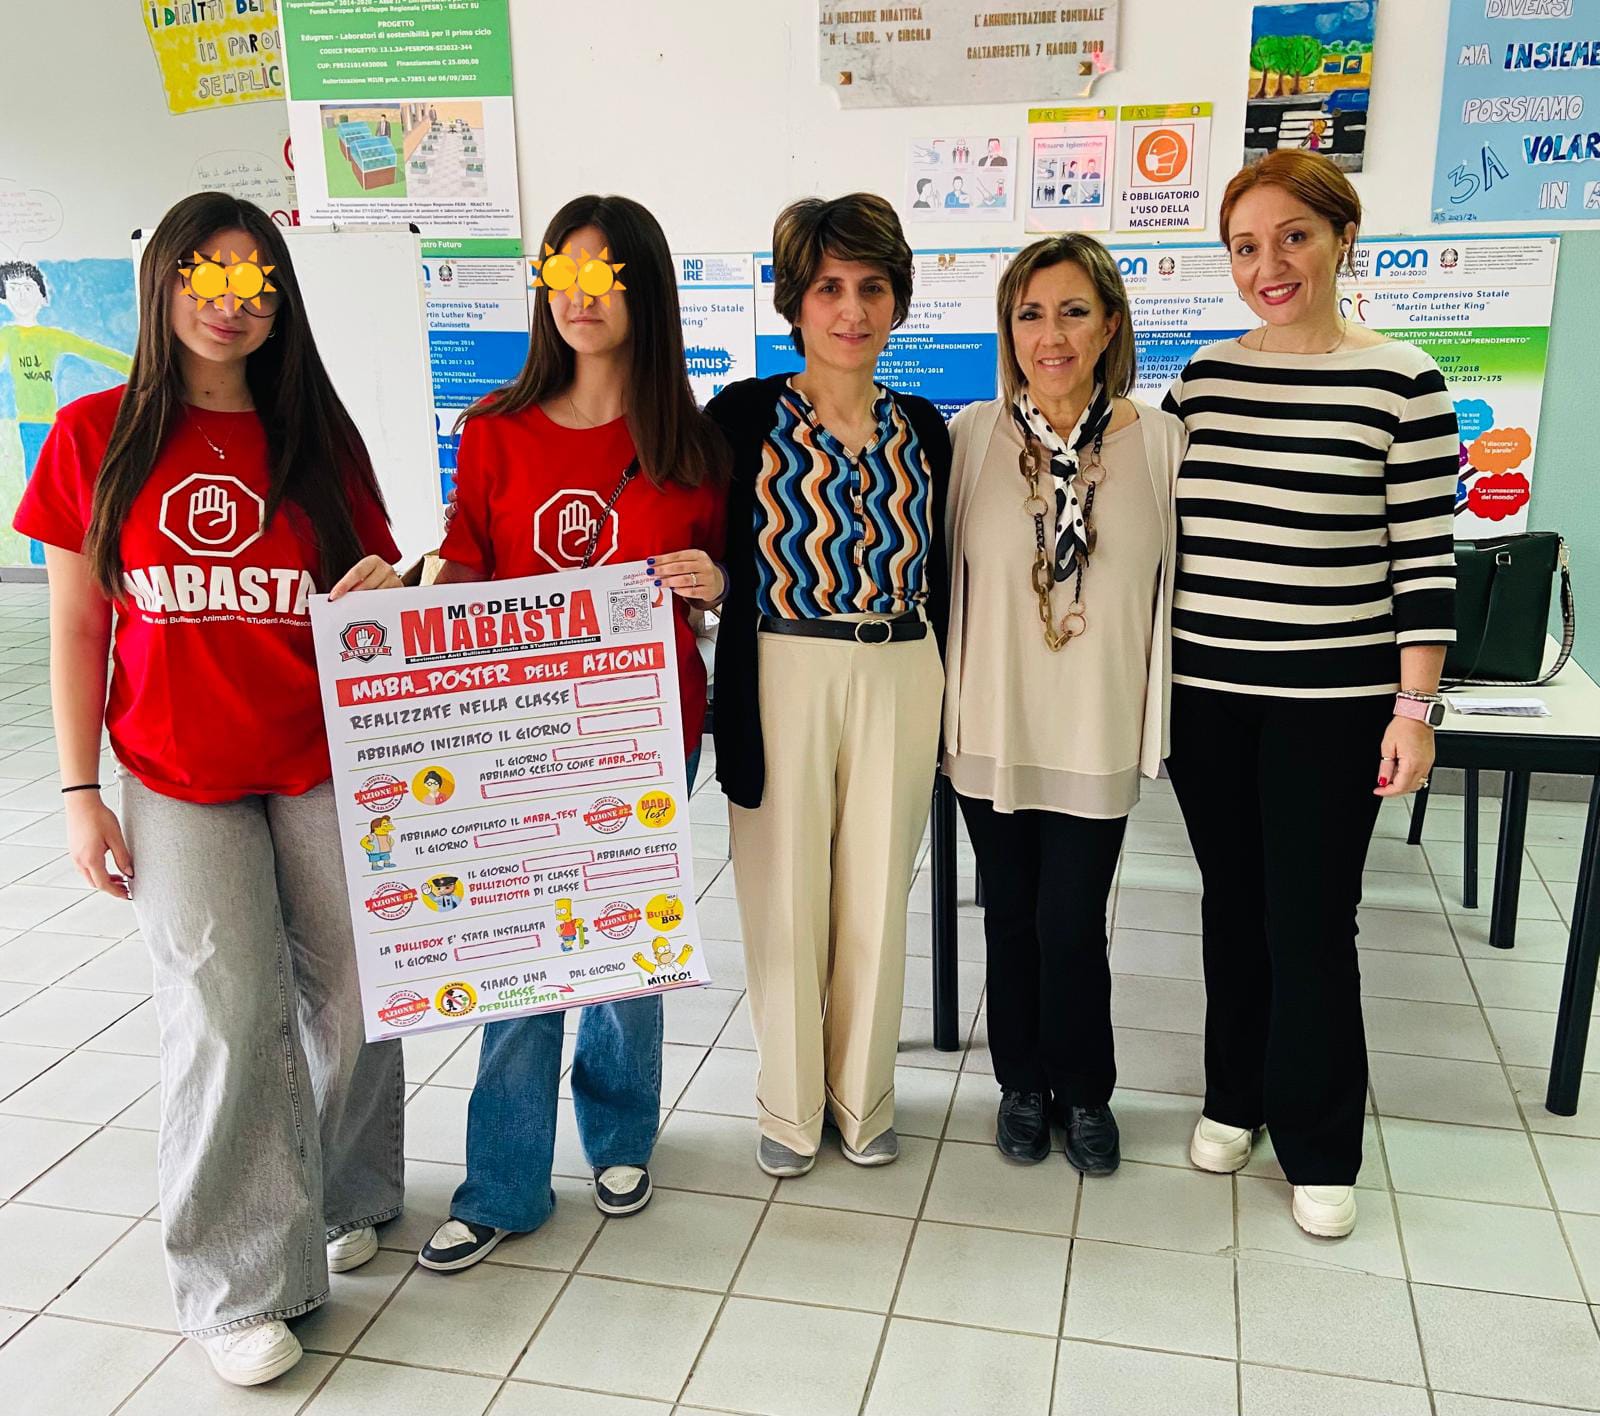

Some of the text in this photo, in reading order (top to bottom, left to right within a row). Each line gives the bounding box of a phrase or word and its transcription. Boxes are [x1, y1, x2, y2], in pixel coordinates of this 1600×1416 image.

[837, 7, 923, 24] DIREZIONE DIDATTICA
[1060, 8, 1105, 23] COMUNALE
[377, 20, 415, 28] PROGETTO
[340, 31, 377, 40] Laboratori
[475, 28, 492, 36] ciclo
[898, 28, 932, 42] CIRCOLO
[967, 41, 1077, 60] CALTANISSETTA 7 MAGGIO
[1457, 43, 1491, 66] MA
[1464, 95, 1584, 124] POSSIAMO
[1037, 141, 1064, 149] Misure
[1122, 190, 1200, 201] È OBBLIGATORIO
[1539, 181, 1569, 210] IN
[1130, 204, 1190, 214] L'USO DELLA
[1129, 217, 1190, 228] MASCHERINA
[438, 241, 463, 249] Futuro
[683, 259, 704, 270] IND
[1375, 248, 1429, 277] pon
[683, 271, 703, 281] IRE
[1134, 296, 1224, 306] Comprensivo Statale
[1374, 290, 1510, 301] Istituto Comprensivo Statale
[426, 301, 500, 310] Comprensivo Statale
[711, 304, 745, 312] Statale
[1151, 307, 1180, 315] Luther
[1430, 302, 1461, 311] Luther
[441, 311, 465, 319] Luther
[1133, 318, 1188, 327] Caltanissetta
[1409, 313, 1470, 322] Caltanissetta
[430, 321, 470, 329] Caltanissetta
[1151, 331, 1192, 339] NAZIONALE
[24, 370, 53, 382] WAR
[447, 592, 566, 620] MODELLO
[202, 613, 235, 623] Animato
[400, 589, 601, 657] MABASTA
[410, 655, 446, 663] Movimento
[447, 652, 462, 660] Anti
[462, 649, 491, 657] Bullismo
[492, 645, 520, 653] Animato
[559, 637, 597, 646] Adolescenti
[351, 647, 654, 702] MABA_POSTER DELLE AZIONI
[350, 689, 570, 730] REALIZZATE NELLA CLASSE
[357, 722, 572, 762] ABBIAMO INIZIATO IL GIORNO
[495, 753, 548, 768] IL GIORNO
[479, 767, 526, 782] ABBIAMO
[529, 762, 564, 775] SCELTO
[566, 758, 595, 770] COME
[361, 784, 404, 802] AZIONE #1
[641, 797, 672, 810] MABA
[589, 809, 618, 822] AZIONE
[644, 806, 668, 820] Test
[400, 808, 578, 843] ABBIAMO COMPILATO IL MABA_TEST
[415, 839, 469, 856] IL GIORNO
[596, 842, 677, 861] ABBIAMO ELETTO
[467, 864, 520, 879] IL GIORNO
[469, 868, 580, 893] BULLIZIOTTO DI CLASSE
[371, 894, 402, 909] AZIONE
[470, 882, 580, 906] BULLIZIOTTA DI CLASSE
[600, 914, 628, 928] AZIONE
[380, 945, 391, 956] LA
[395, 937, 444, 954] BULLIBOX
[461, 929, 489, 943] STATA
[493, 920, 546, 938] INSTALLATA
[394, 952, 448, 969] IL GIORNO
[569, 961, 626, 980] DAL GIORNO
[481, 971, 548, 992] SIAMO UNA
[647, 971, 692, 987] MITICO!
[498, 985, 536, 1001] CLASSE
[478, 992, 558, 1014] DEBULLIZZATA
[384, 1004, 415, 1019] AZIONE
